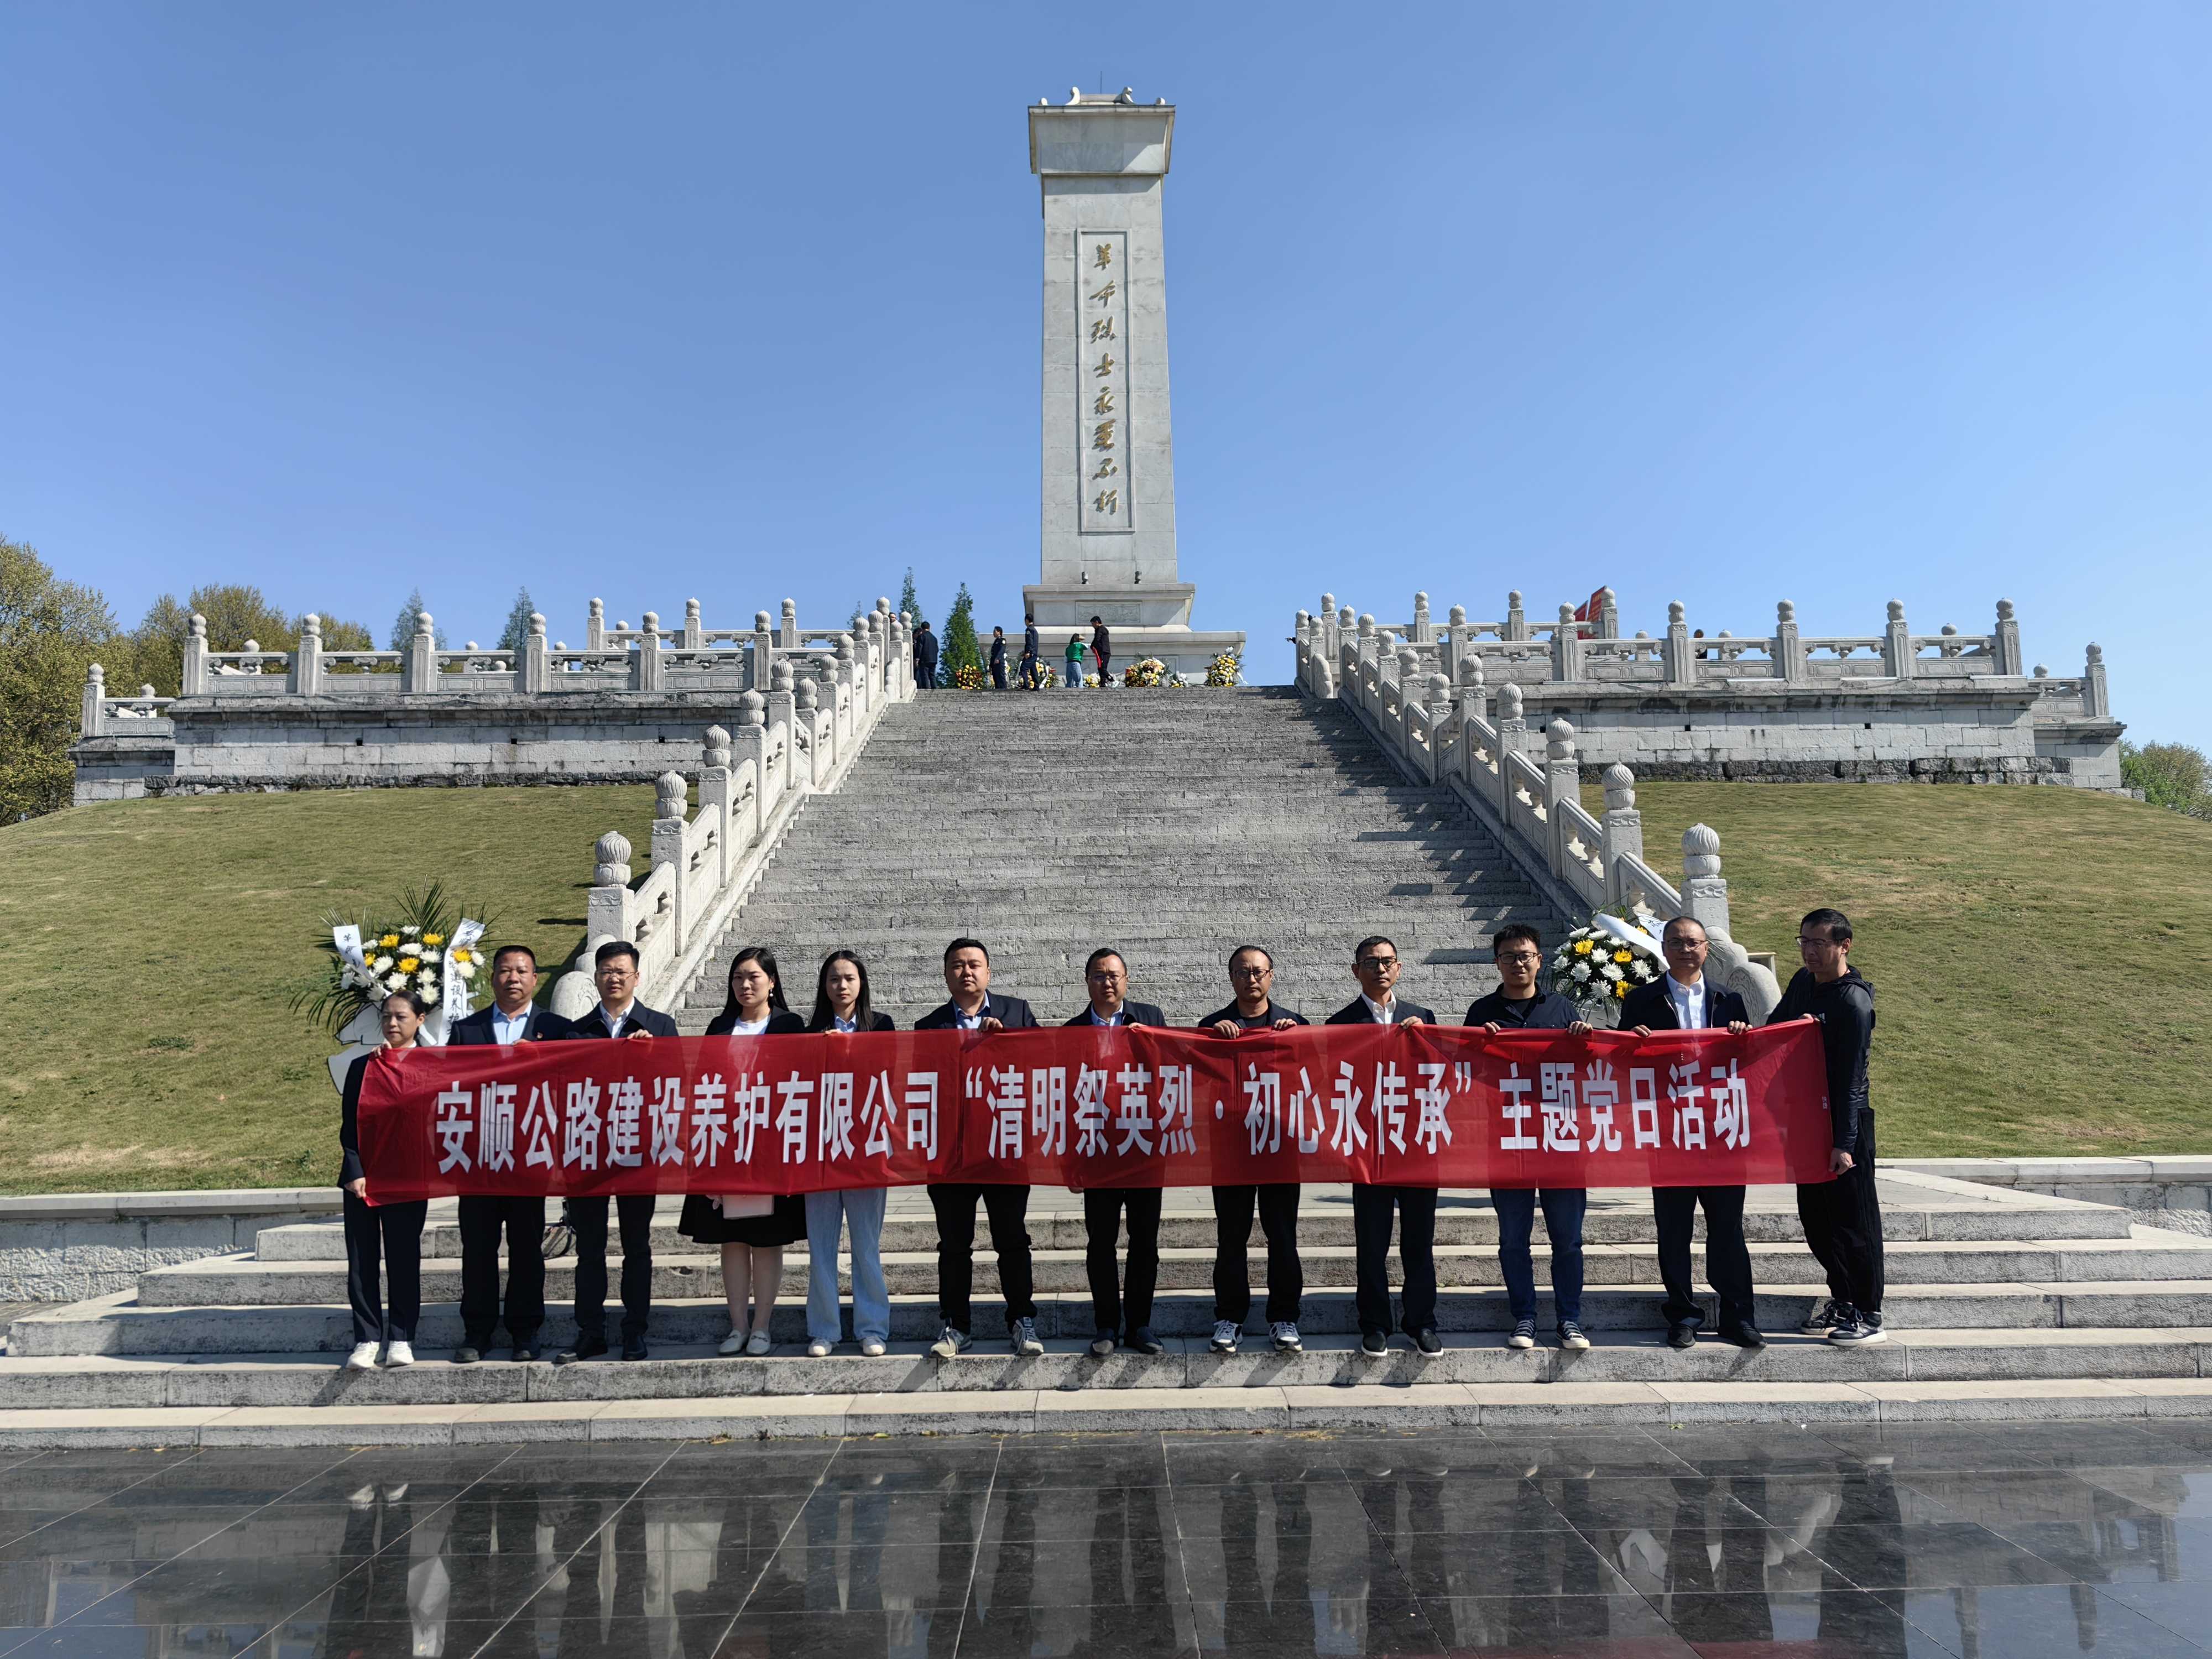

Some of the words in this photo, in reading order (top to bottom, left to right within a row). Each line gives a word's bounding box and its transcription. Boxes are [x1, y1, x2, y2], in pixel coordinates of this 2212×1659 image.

[1088, 242, 1119, 515] 革命烈士永垂不朽
